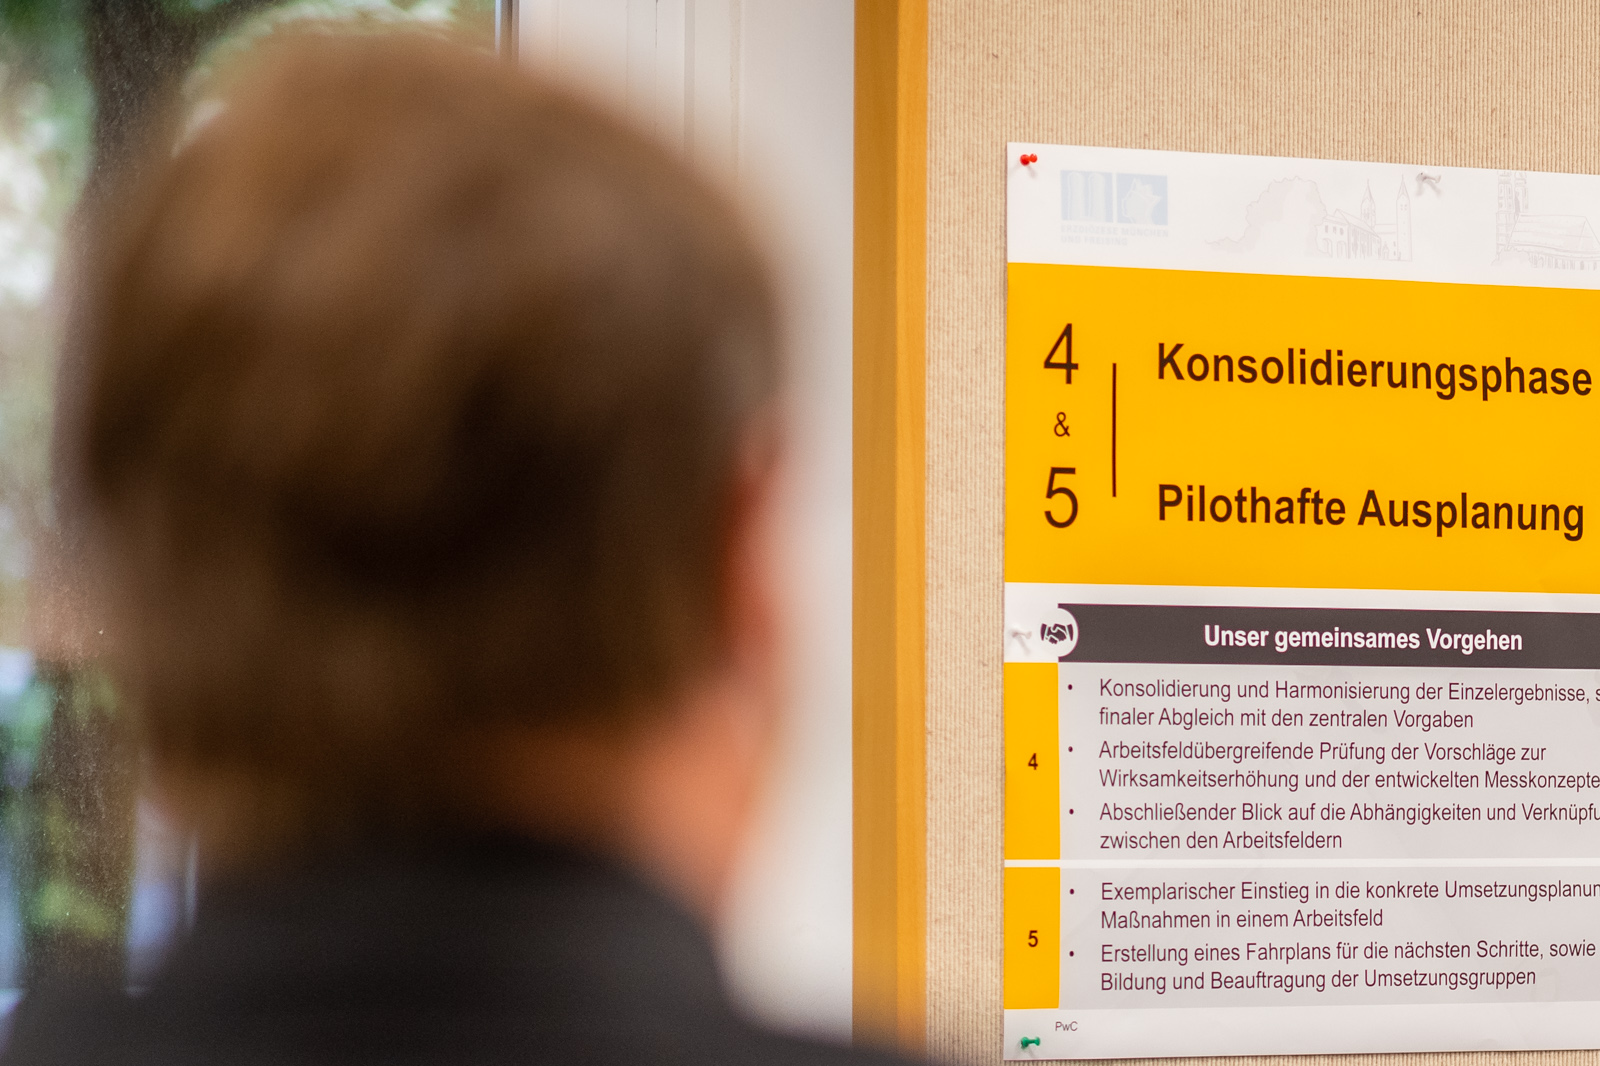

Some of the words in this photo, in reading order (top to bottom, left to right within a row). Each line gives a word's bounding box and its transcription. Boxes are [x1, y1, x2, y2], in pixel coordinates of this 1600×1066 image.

[1043, 323, 1079, 385] 4
[1157, 341, 1593, 402] Konsolidierungsphase
[1053, 411, 1071, 438] &
[1044, 466, 1079, 529] 5
[1158, 482, 1346, 527] Pilothafte
[1357, 488, 1584, 543] Ausplanung
[1204, 623, 1270, 648] Unser
[1274, 625, 1421, 654] gemeinsames
[1425, 627, 1523, 656] Vorgehen
[1100, 677, 1231, 703] Konsolidierung
[1237, 679, 1269, 700] und
[1275, 679, 1410, 705] Harmonisierung
[1415, 680, 1444, 702] der
[1448, 681, 1590, 706] Einzelergebnisse,
[1098, 706, 1155, 727] finaler
[1157, 706, 1234, 731] Abgleich
[1240, 707, 1267, 728] mit
[1271, 707, 1304, 728] den
[1308, 708, 1388, 729] zentralen
[1393, 709, 1474, 733] Vorgaben
[1027, 753, 1039, 770] 4
[1098, 739, 1314, 765] Arbeitsfeldübergreifende
[1319, 740, 1386, 766] Prüfung
[1391, 741, 1420, 761] der
[1423, 742, 1516, 766] Vorschläge
[1520, 746, 1547, 762] zur
[1098, 767, 1299, 794] Wirksamkeitserhöhung
[1305, 769, 1336, 789] und
[1341, 768, 1371, 789] der
[1374, 769, 1479, 789] entwickelten
[1484, 770, 1600, 794] Messkonzepte
[1099, 801, 1237, 822] Abschließender
[1242, 801, 1283, 822] Blick
[1288, 801, 1317, 822] auf
[1320, 801, 1346, 822] die
[1349, 802, 1481, 826] Abhängigkeiten
[1486, 802, 1516, 822] und
[1099, 830, 1181, 850] zwischen
[1186, 830, 1219, 850] den
[1222, 829, 1342, 850] Arbeitsfeldern
[1101, 881, 1236, 905] Exemplarischer
[1241, 880, 1309, 904] Einstieg
[1315, 880, 1330, 899] in
[1334, 879, 1361, 900] die
[1366, 879, 1439, 900] konkrete
[1101, 909, 1211, 930] Maßnahmen
[1216, 909, 1231, 929] in
[1236, 909, 1289, 929] einem
[1292, 907, 1383, 928] Arbeitsfeld
[1027, 931, 1039, 948] 5
[1101, 942, 1188, 968] Erstellung
[1193, 942, 1241, 963] eines
[1246, 941, 1332, 966] Fahrplans
[1335, 940, 1359, 960] für
[1363, 940, 1389, 960] die
[1394, 939, 1471, 960] nächsten
[1476, 939, 1544, 961] Schritte,
[1549, 938, 1596, 958] sowie
[1101, 971, 1167, 996] Bildung
[1172, 970, 1205, 990] und
[1210, 970, 1326, 994] Beauftragung
[1331, 968, 1360, 989] der
[1364, 968, 1536, 992] Umsetzungsgruppen
[1054, 1019, 1079, 1032] PwC
